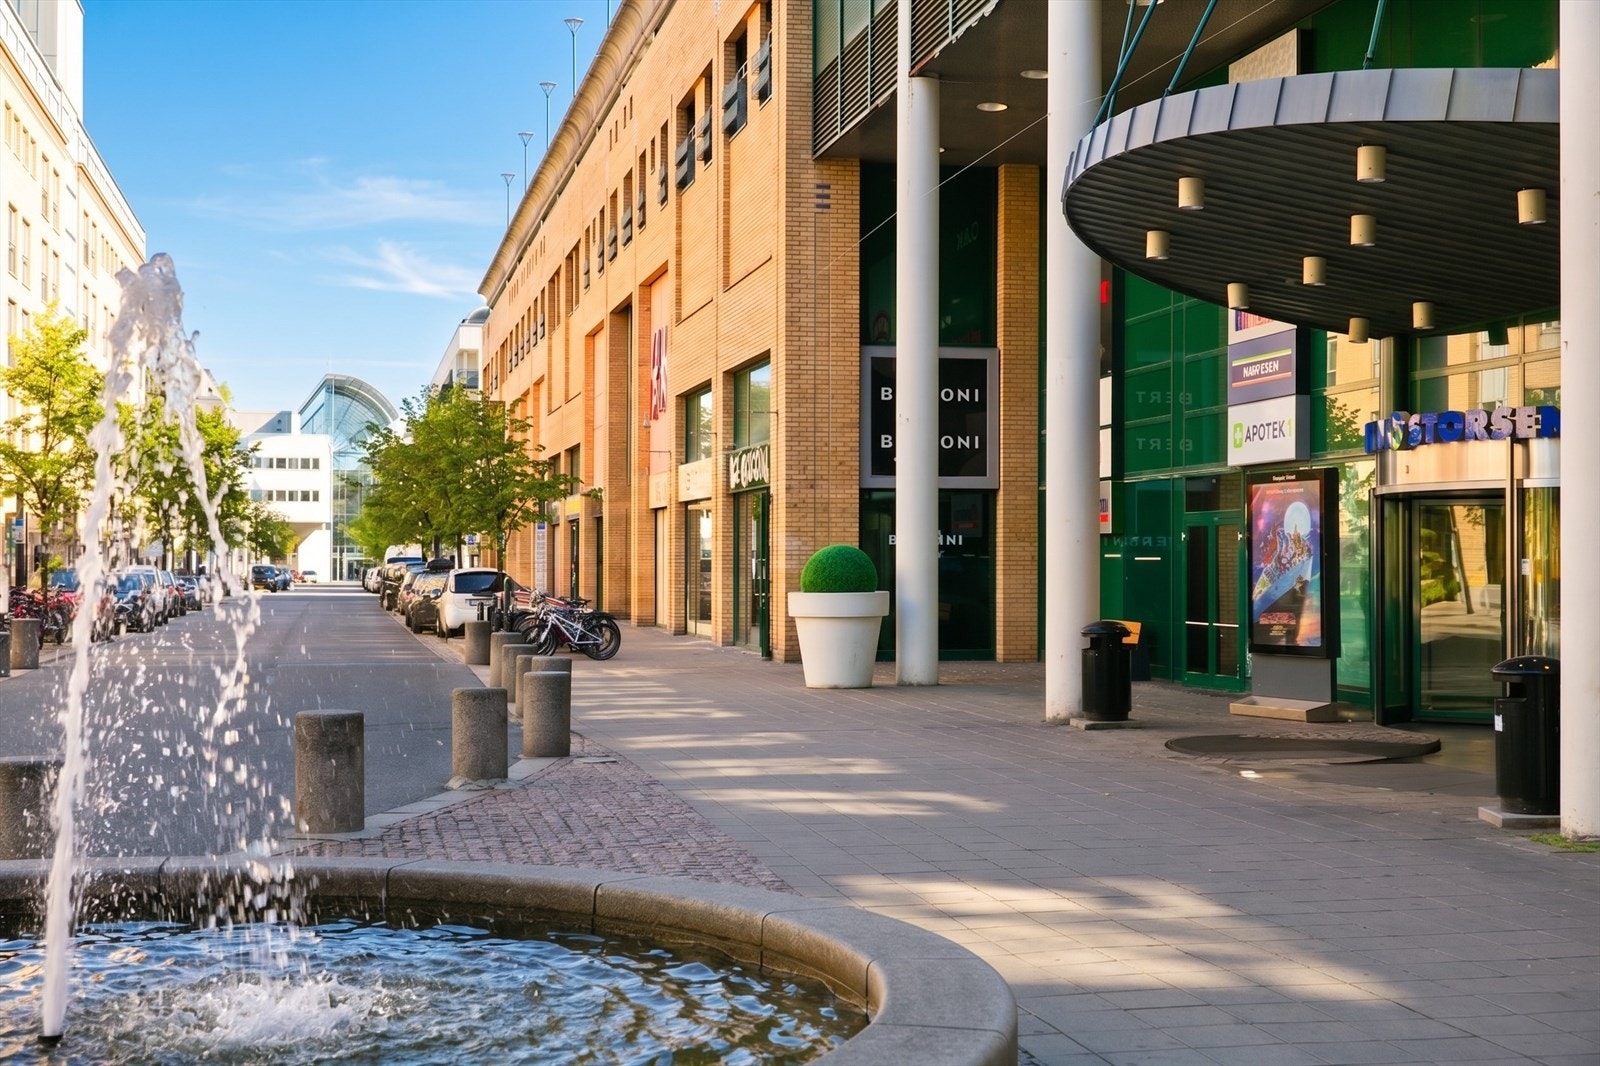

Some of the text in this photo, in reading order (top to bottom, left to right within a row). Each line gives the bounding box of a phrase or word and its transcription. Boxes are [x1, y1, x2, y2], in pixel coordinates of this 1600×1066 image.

[880, 387, 980, 403] BONI
[1244, 418, 1292, 443] APOTEK 1
[880, 434, 980, 450] BONI
